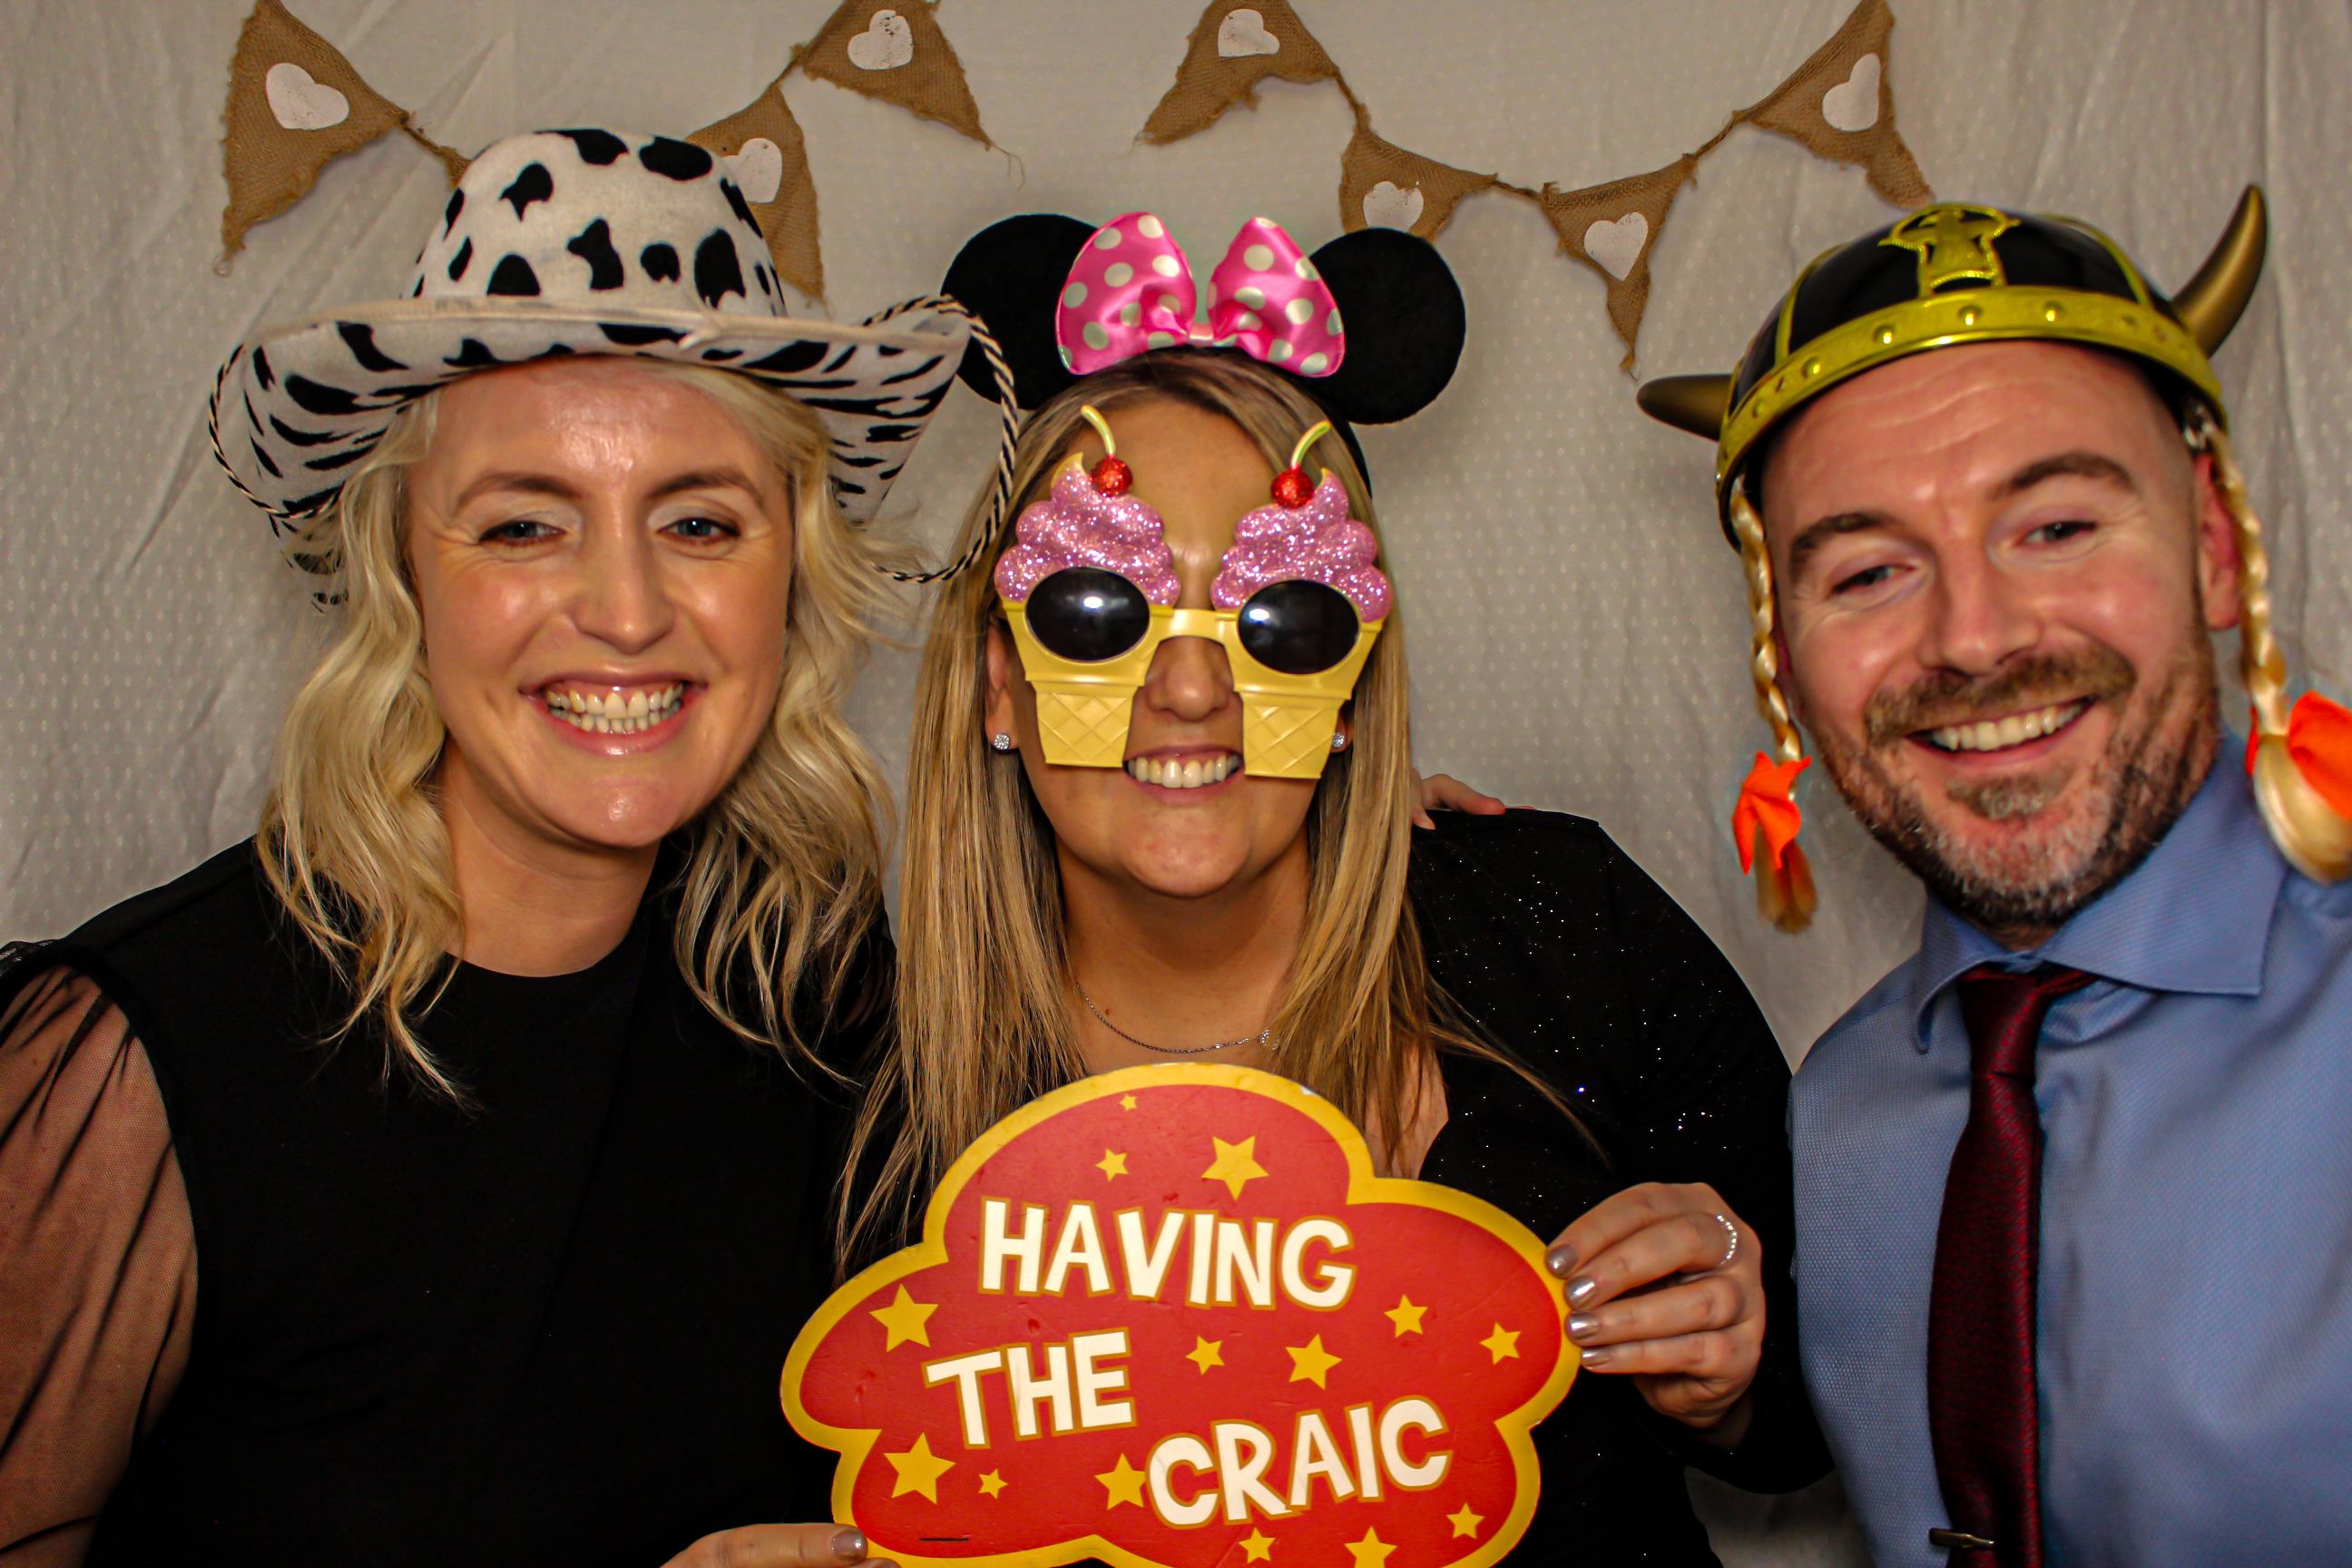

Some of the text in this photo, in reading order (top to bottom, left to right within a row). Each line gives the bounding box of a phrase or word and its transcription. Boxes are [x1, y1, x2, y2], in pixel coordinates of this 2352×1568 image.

[982, 1200, 1353, 1308] HAVING
[926, 1330, 1133, 1446] THE
[1149, 1398, 1449, 1525] CRAIC
